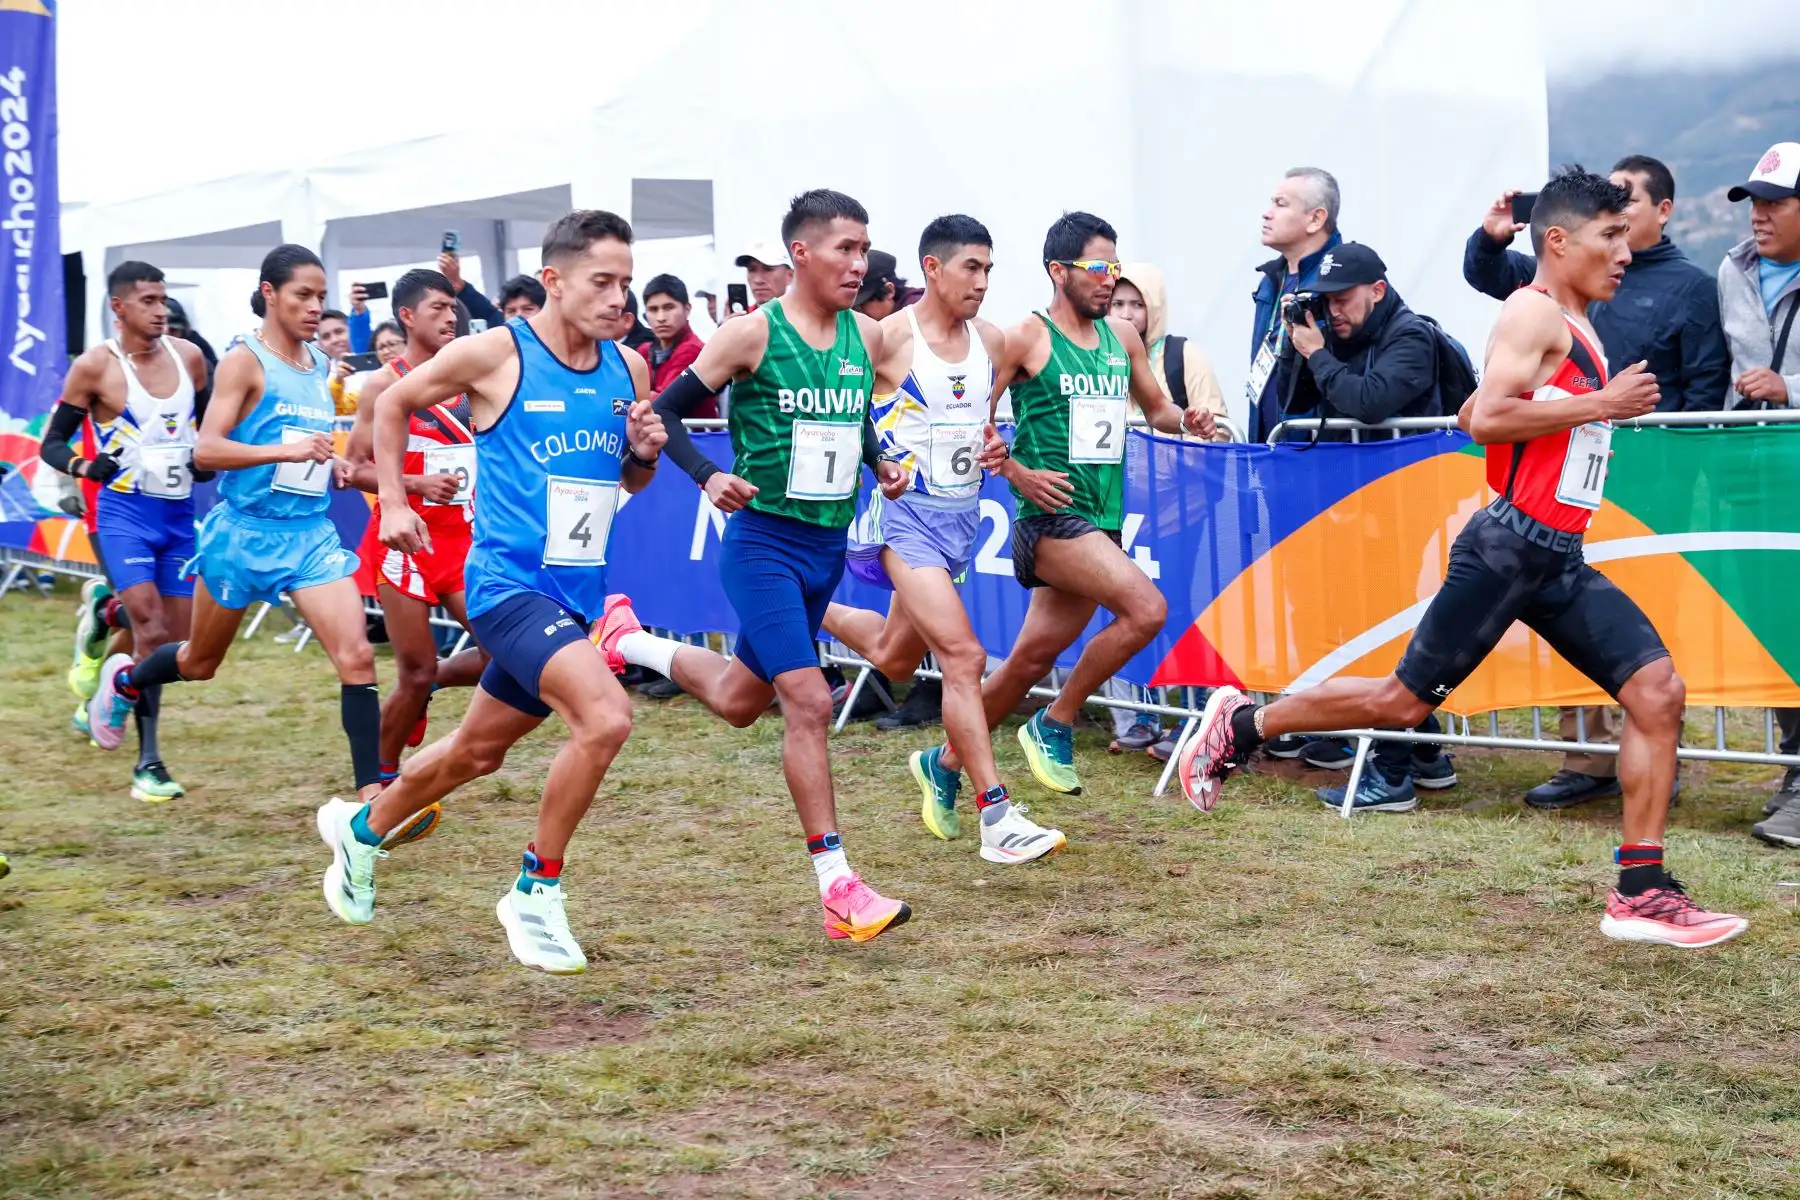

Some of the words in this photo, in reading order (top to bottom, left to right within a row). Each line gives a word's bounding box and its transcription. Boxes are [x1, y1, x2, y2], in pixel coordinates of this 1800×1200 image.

[1060, 373, 1129, 398] BOLIVIA
[778, 388, 865, 414] BOLIVIA
[530, 429, 623, 464] COLOMBI
[1095, 421, 1112, 449] 2
[824, 450, 837, 484] 1
[951, 446, 972, 476] 6
[1582, 453, 1604, 491] 11
[165, 465, 182, 489] 5
[439, 466, 469, 492] 0
[568, 512, 592, 548] 4
